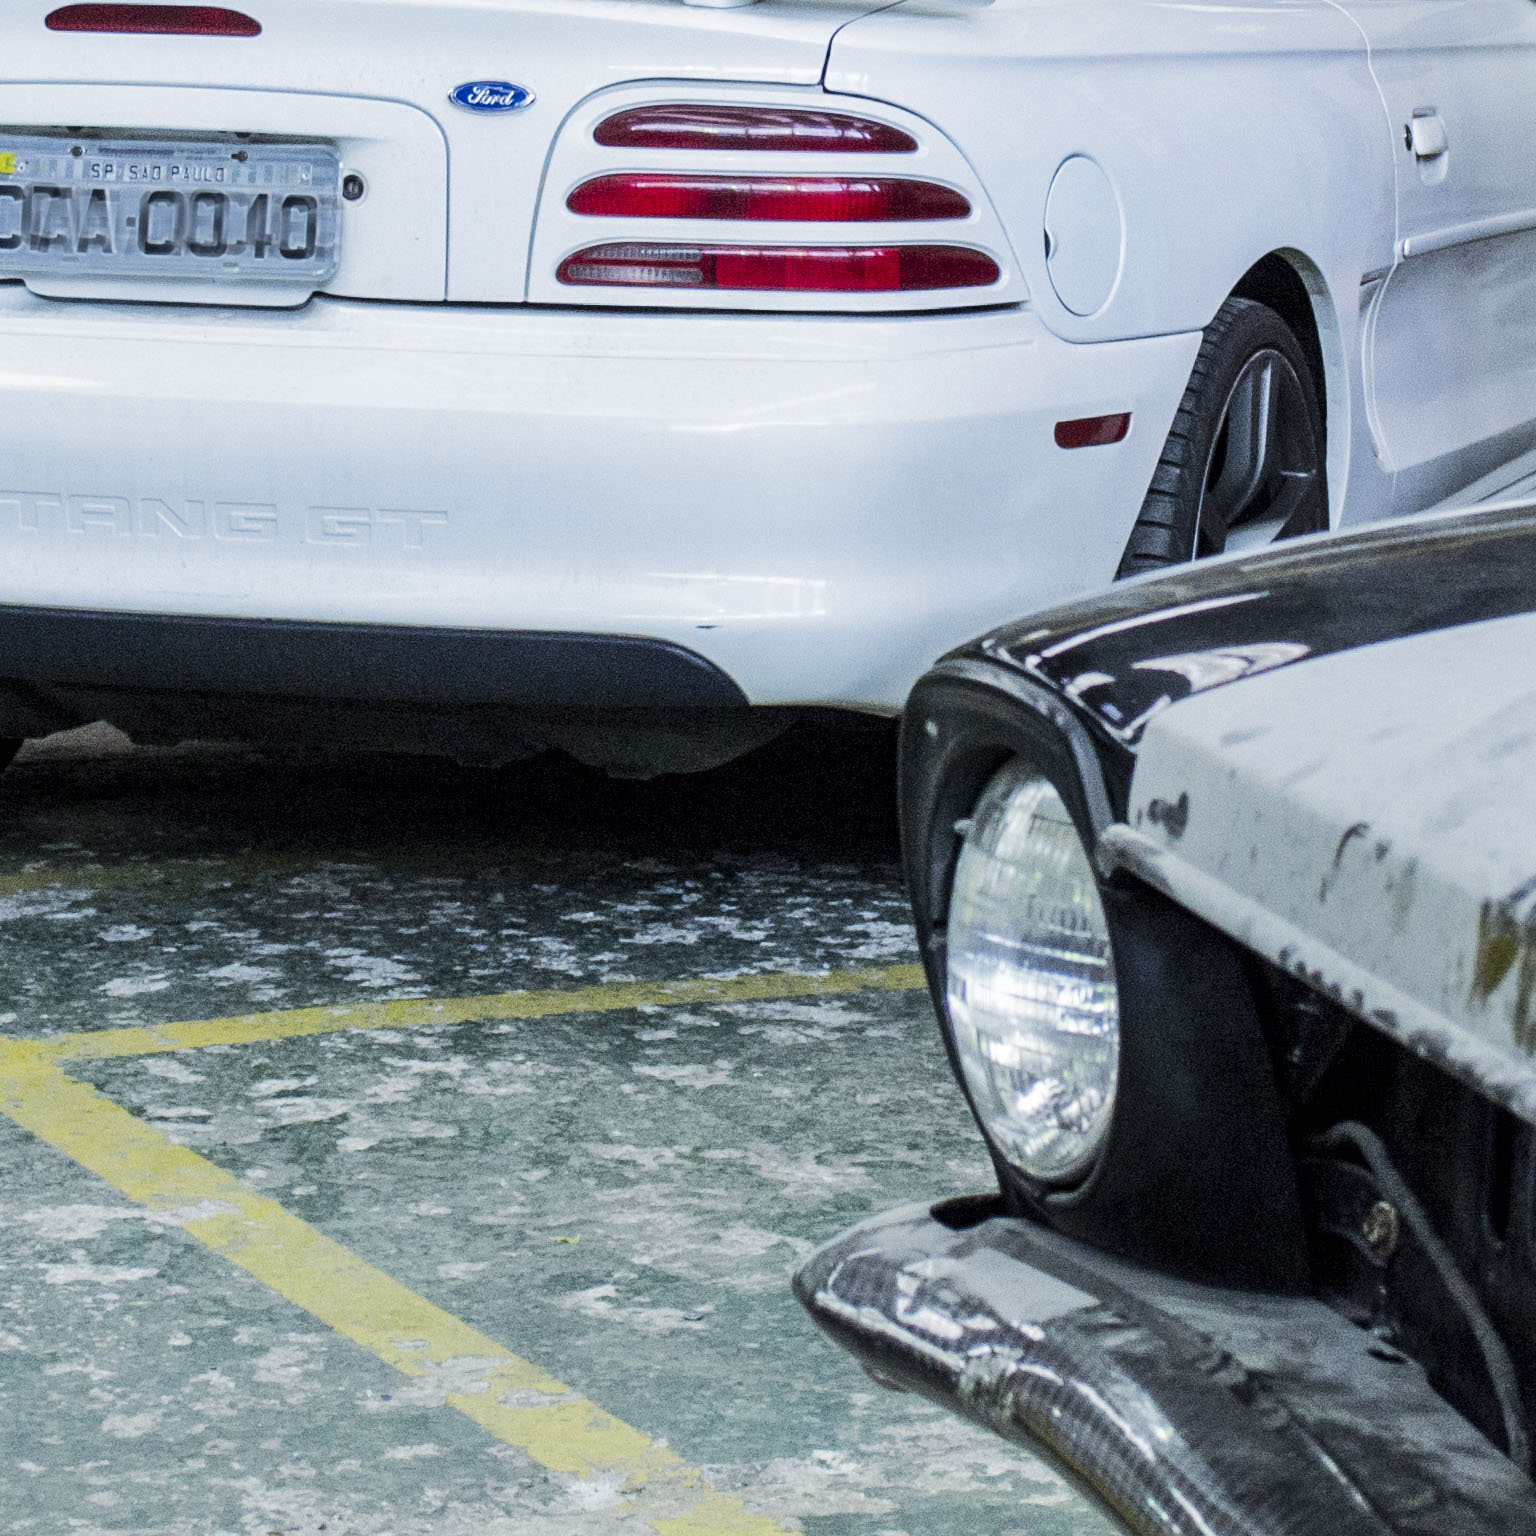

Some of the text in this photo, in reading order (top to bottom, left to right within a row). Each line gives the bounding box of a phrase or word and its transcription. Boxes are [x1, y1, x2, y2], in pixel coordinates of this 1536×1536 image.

[467, 85, 519, 106] Ford
[171, 166, 226, 183] PAULO
[305, 505, 449, 550] GT
